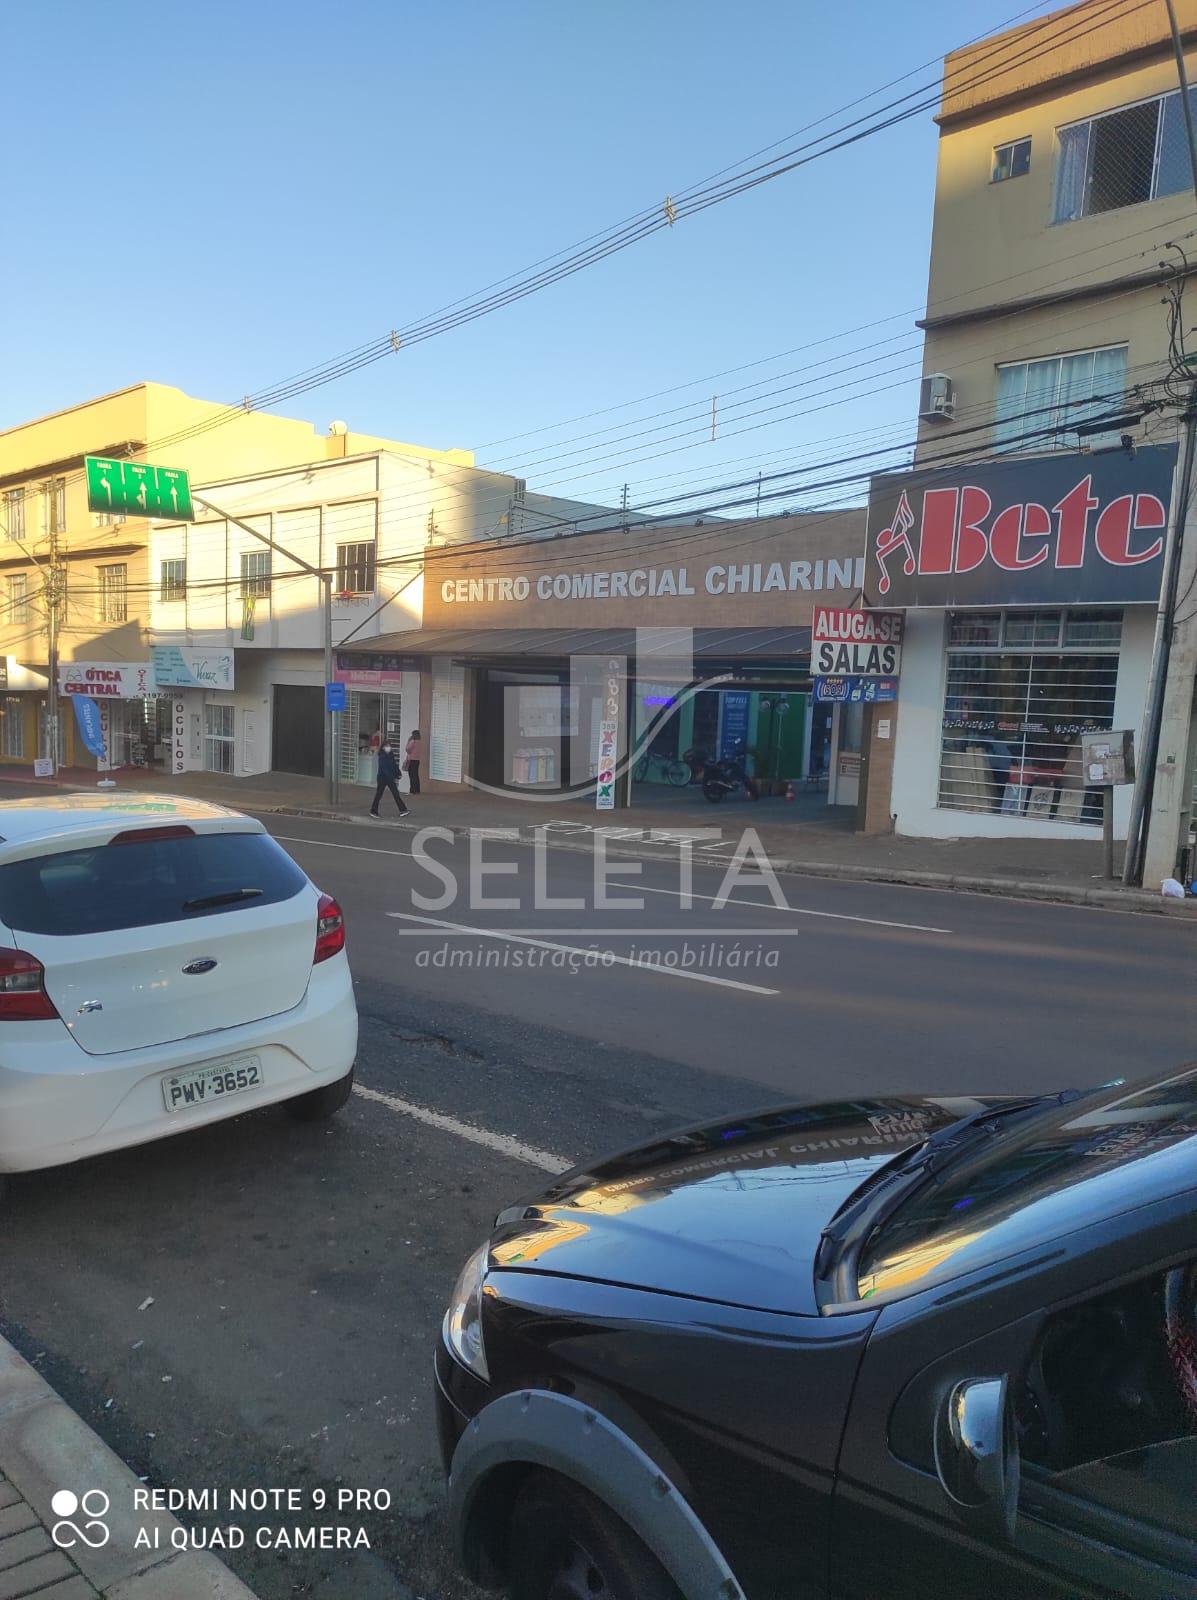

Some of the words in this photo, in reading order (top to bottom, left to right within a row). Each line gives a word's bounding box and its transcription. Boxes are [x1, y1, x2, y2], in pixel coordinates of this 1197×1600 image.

[918, 474, 1166, 575] Bete
[441, 576, 530, 603] CENTRO
[536, 568, 696, 601] COMERCIAL
[705, 557, 865, 594] CHIARINI
[816, 610, 901, 641] ALUGA-SE
[818, 642, 896, 674] SALAS
[64, 682, 121, 695] CENTRAL
